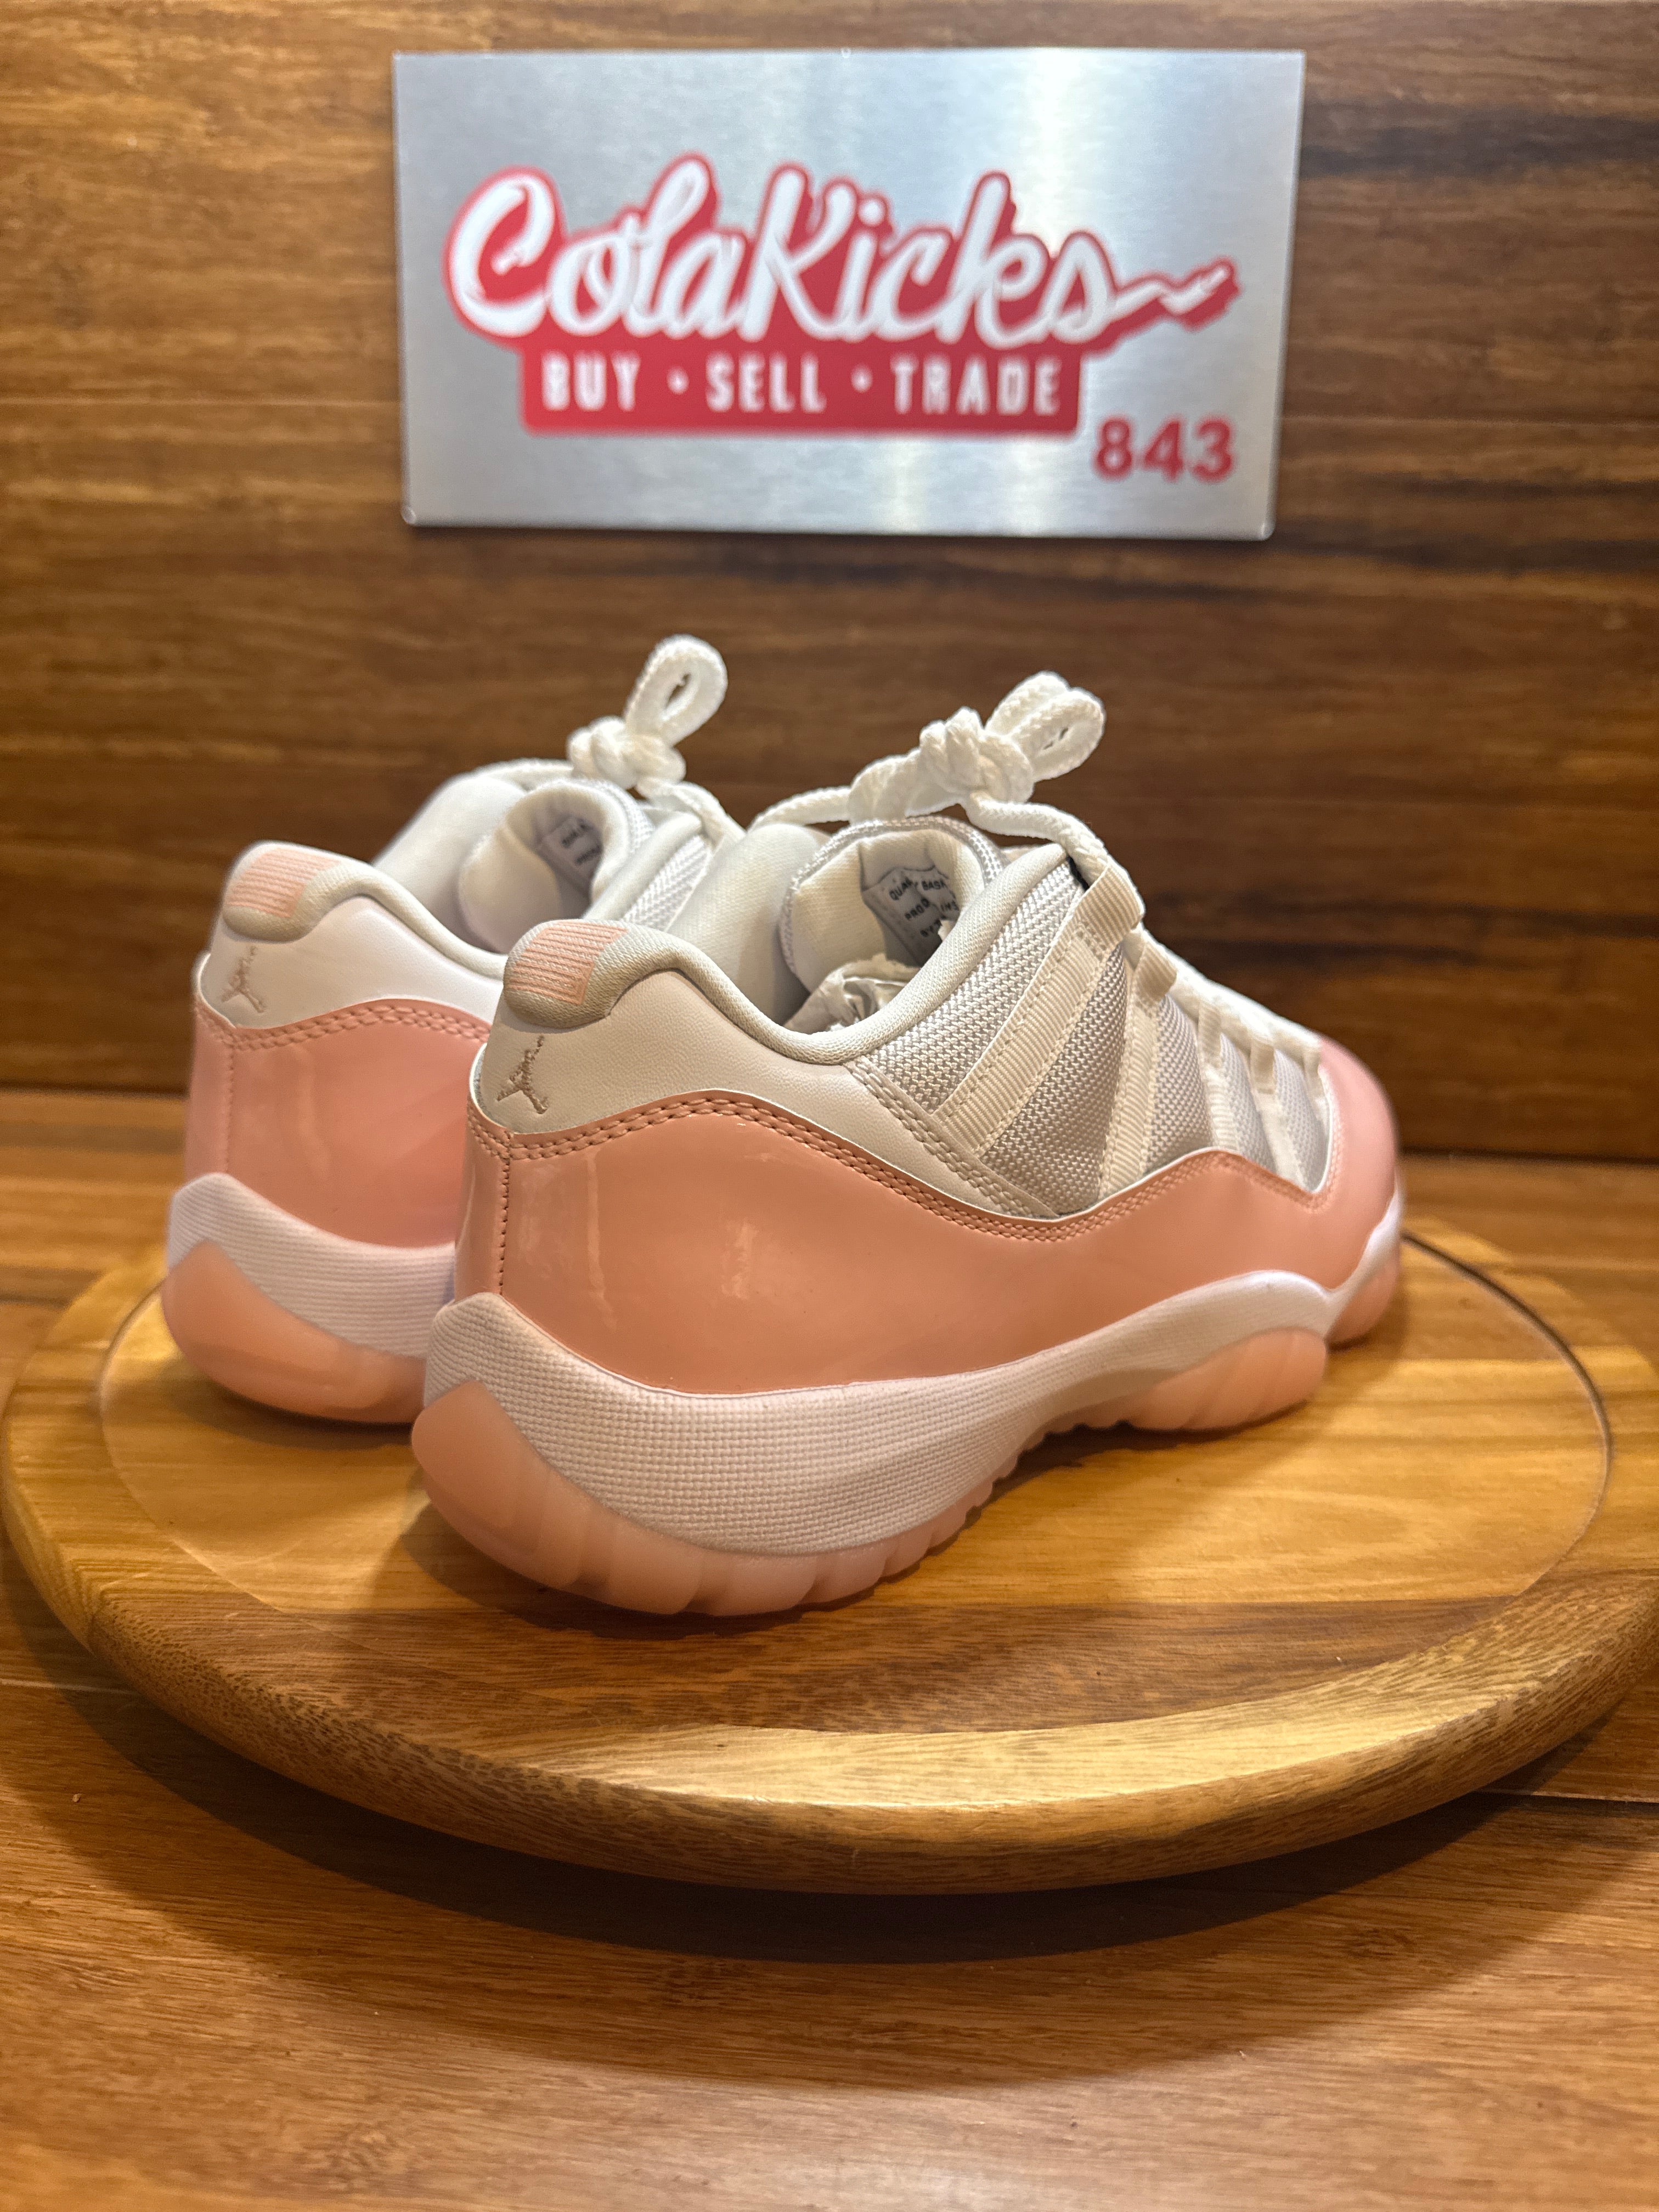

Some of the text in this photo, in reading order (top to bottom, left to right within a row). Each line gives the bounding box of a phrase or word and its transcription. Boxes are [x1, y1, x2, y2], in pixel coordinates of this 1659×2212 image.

[445, 156, 1229, 350] ColaKicks
[541, 350, 1062, 415] BUY SELL TRADE
[1094, 414, 1235, 482] 843
